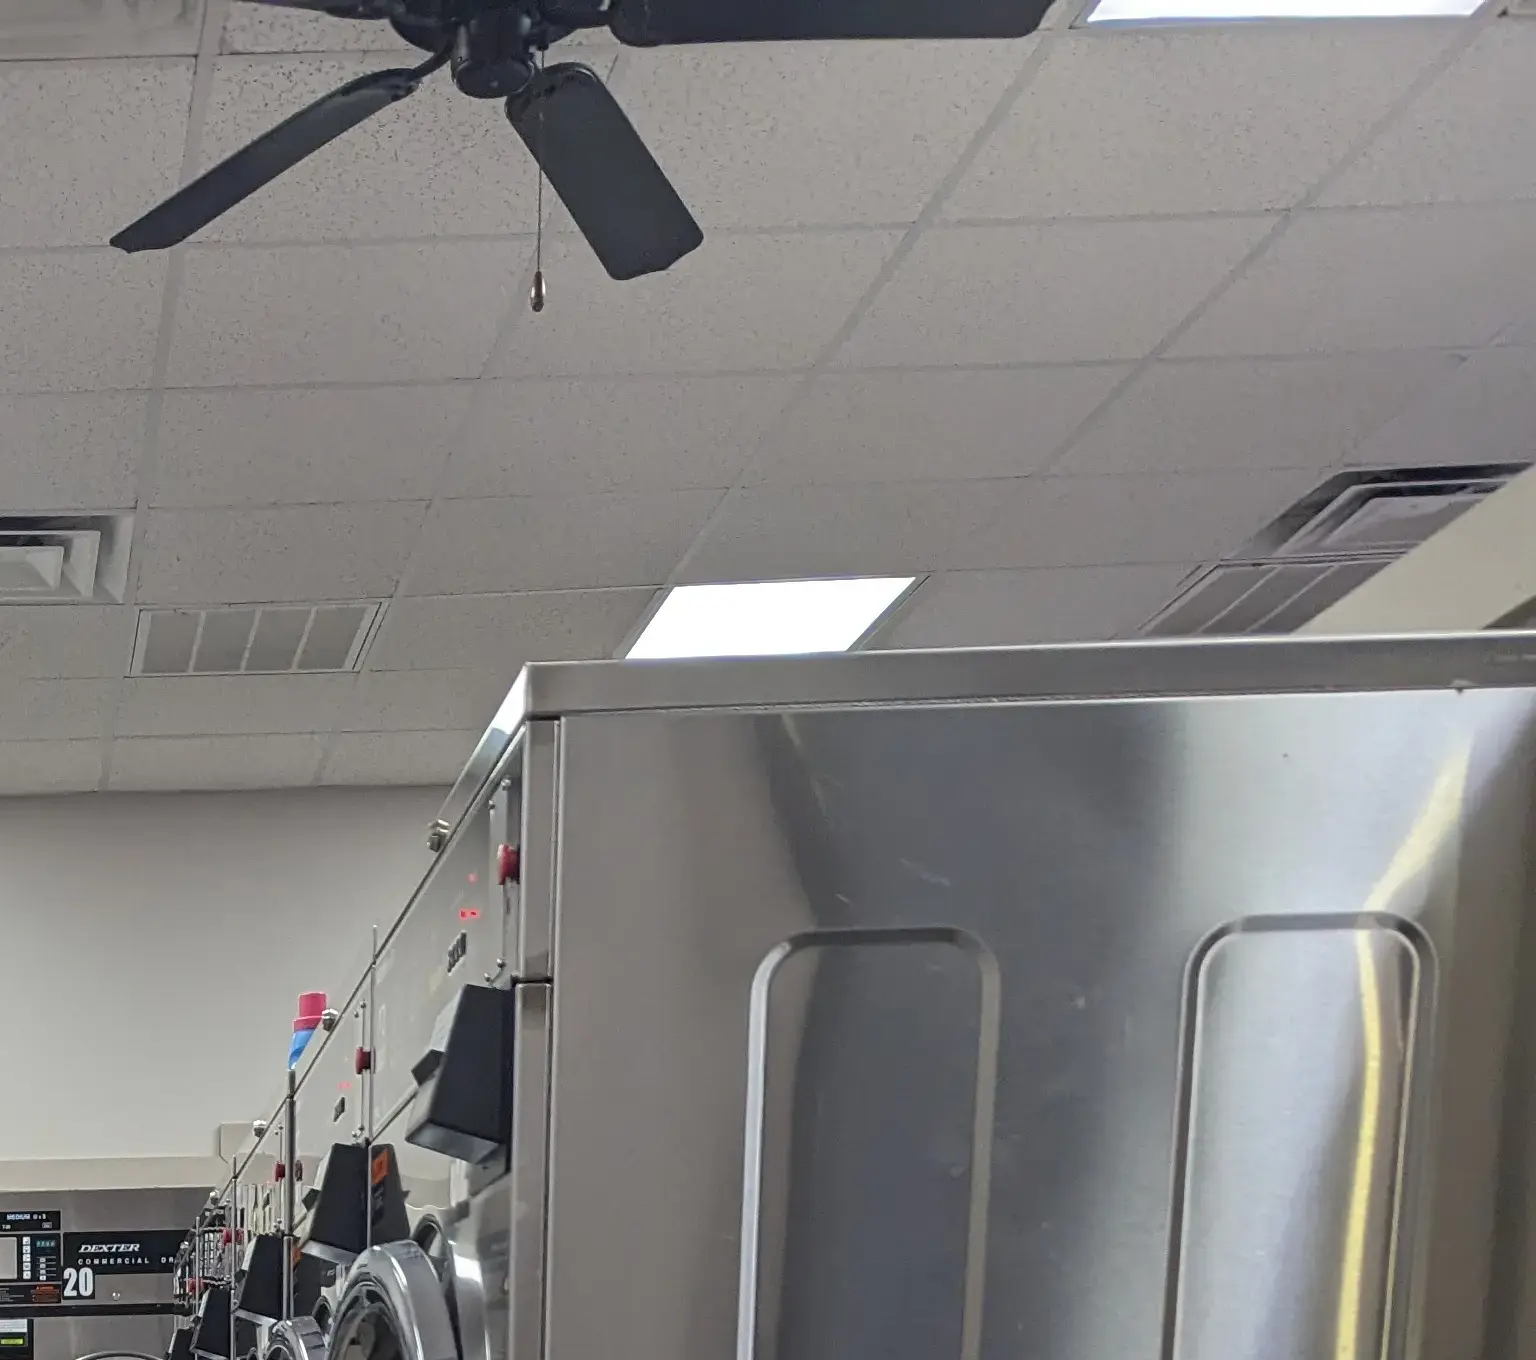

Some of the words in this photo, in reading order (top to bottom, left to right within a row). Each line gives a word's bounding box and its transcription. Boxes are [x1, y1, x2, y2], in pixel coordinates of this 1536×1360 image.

[78, 1243, 140, 1253] DEXTER
[77, 1257, 150, 1265] COMMERCIAL
[63, 1267, 93, 1297] 20
